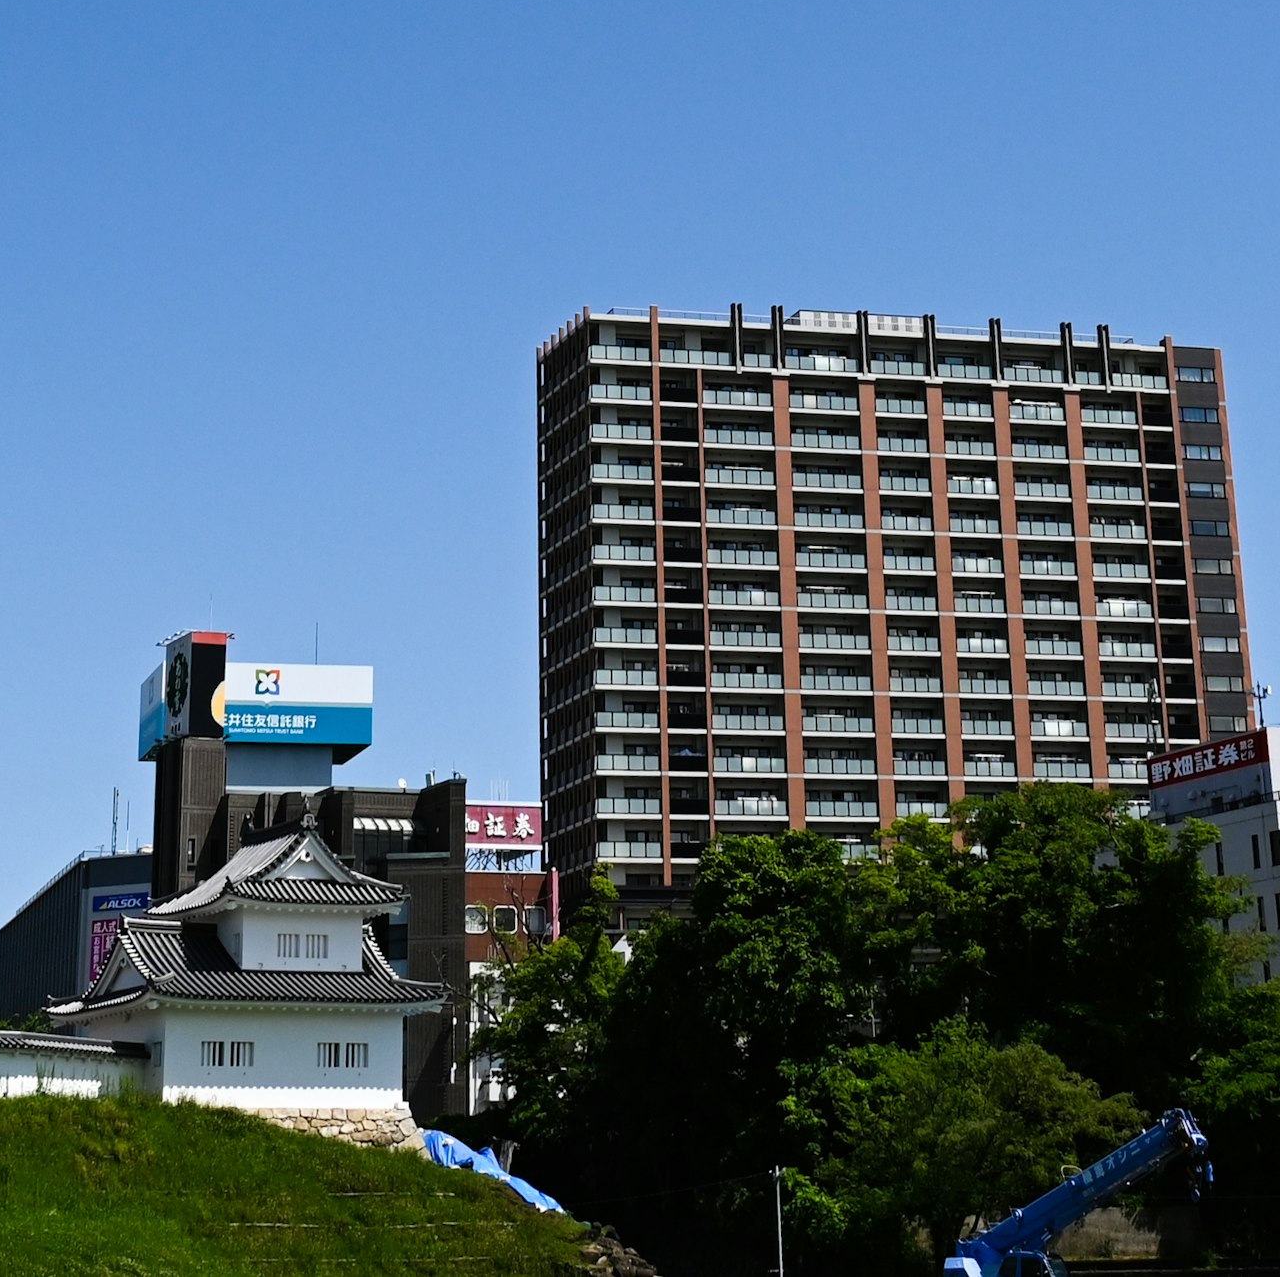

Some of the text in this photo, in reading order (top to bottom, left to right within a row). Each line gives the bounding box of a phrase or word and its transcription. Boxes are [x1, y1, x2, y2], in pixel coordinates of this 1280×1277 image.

[1240, 750, 1255, 761] ビル
[1151, 743, 1239, 783] 野畑証券
[107, 898, 142, 909] ALSOK
[93, 921, 116, 933] 成人式
